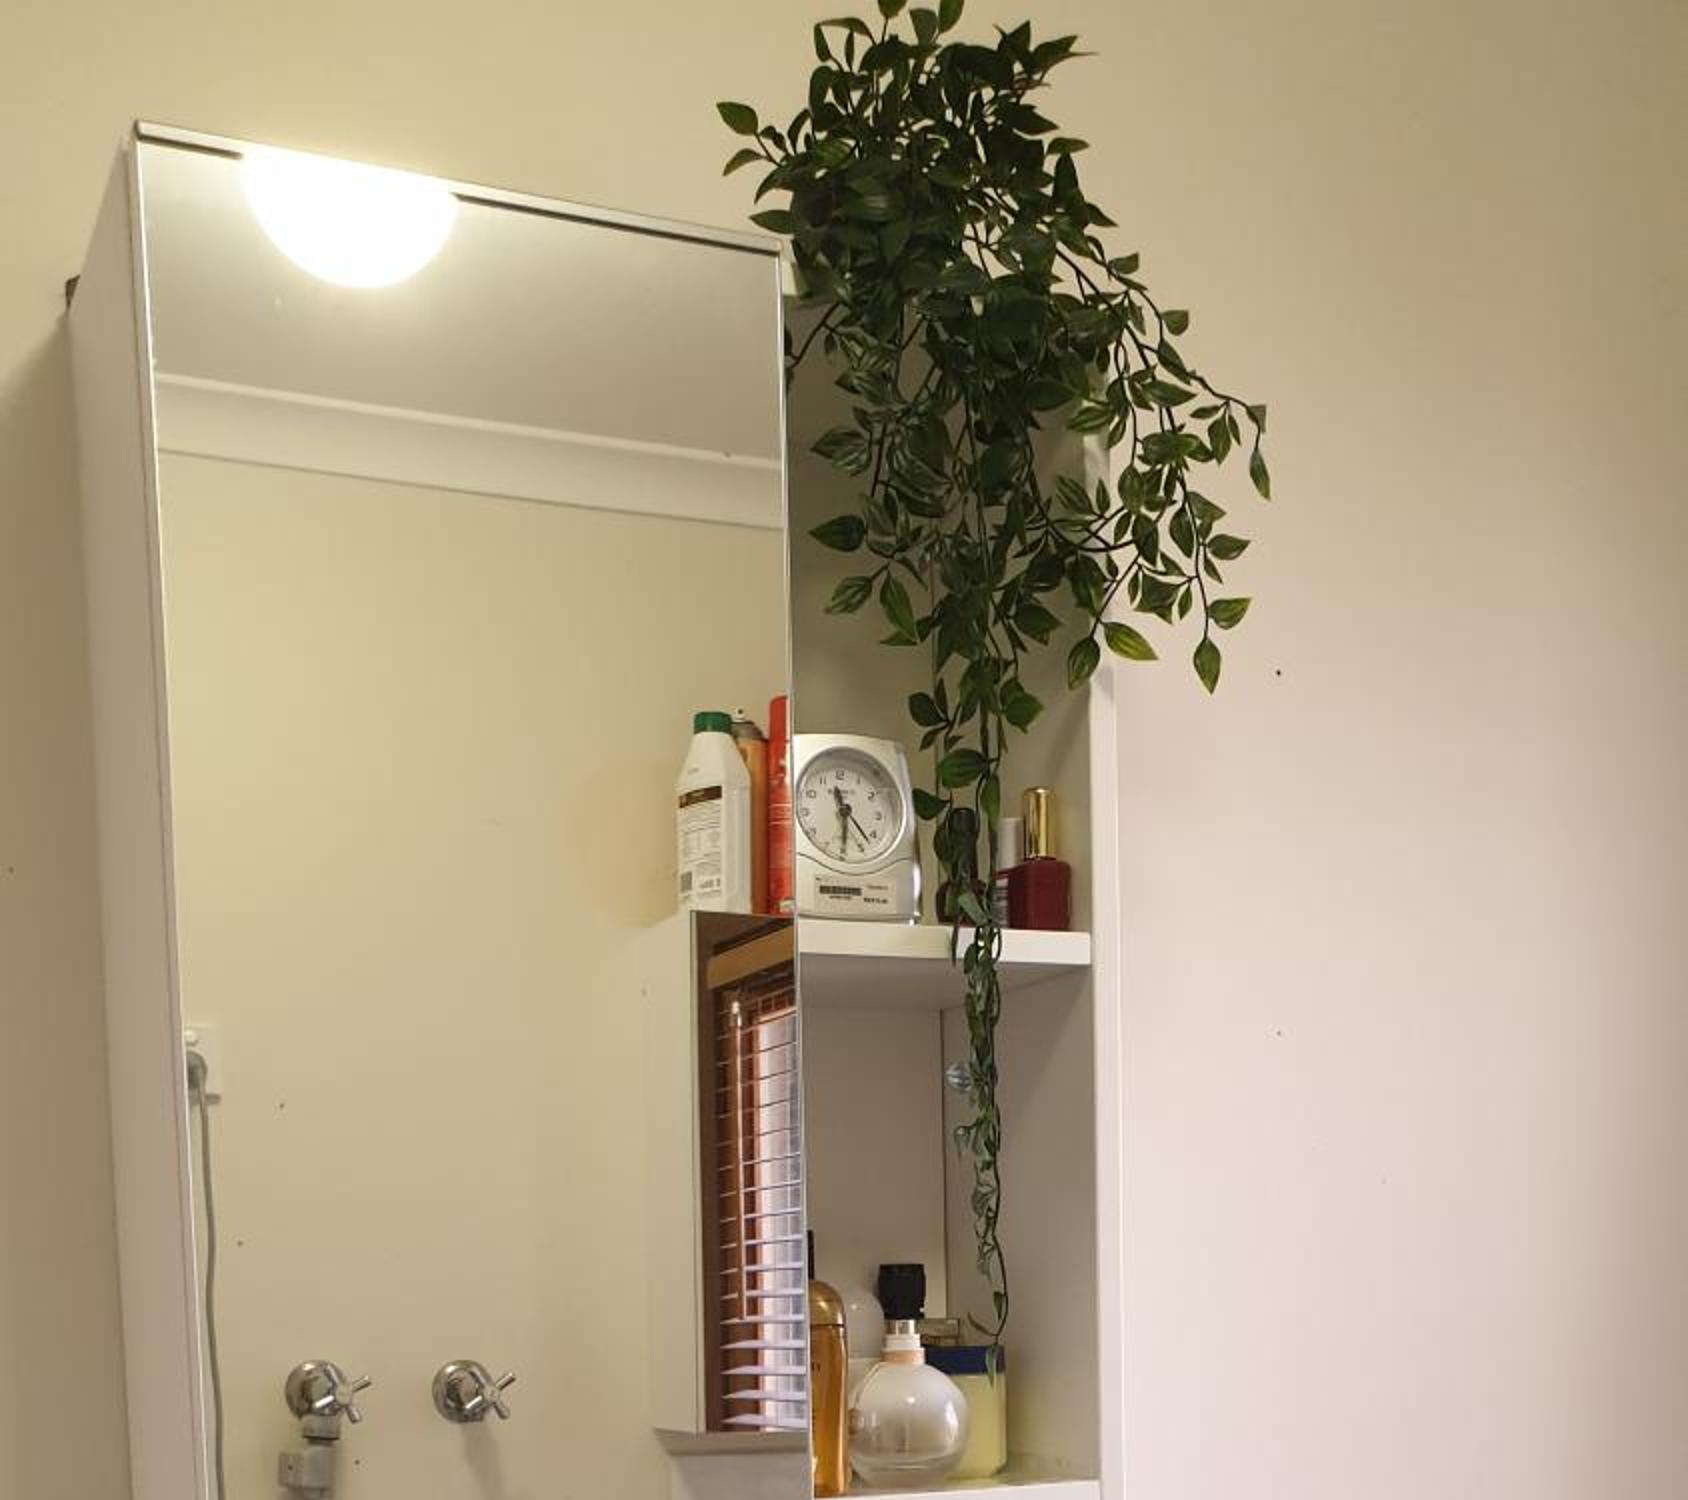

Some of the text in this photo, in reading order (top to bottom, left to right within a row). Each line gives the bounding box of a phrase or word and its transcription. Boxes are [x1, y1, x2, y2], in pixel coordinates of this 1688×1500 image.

[835, 770, 845, 780] 12
[867, 788, 875, 801] 2
[869, 829, 878, 839] 4
